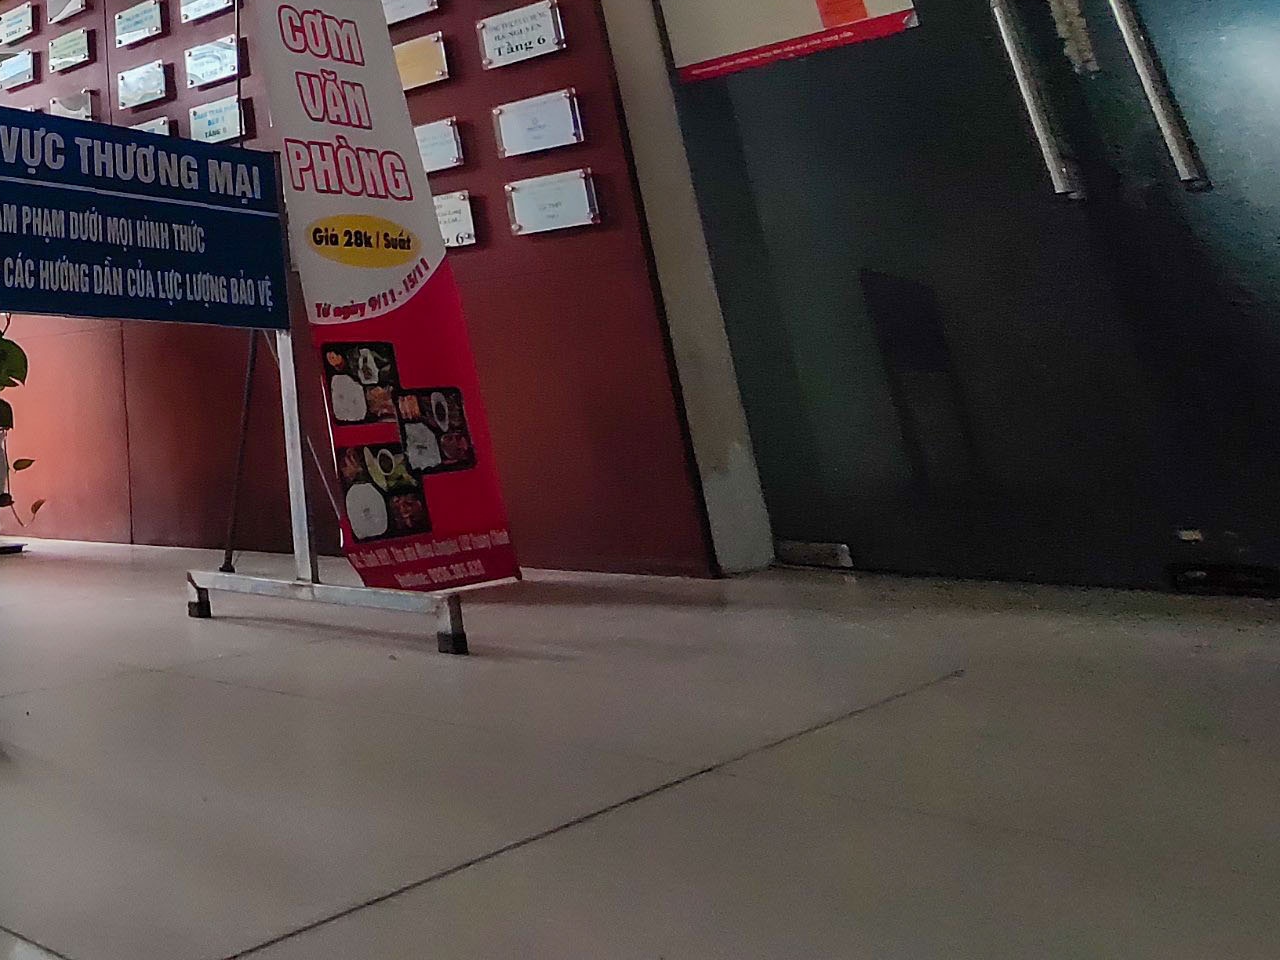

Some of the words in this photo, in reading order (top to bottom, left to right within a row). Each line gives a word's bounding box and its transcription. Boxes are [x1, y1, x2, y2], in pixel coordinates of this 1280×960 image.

[278, 4, 365, 66] CƠM
[537, 36, 546, 45] 6
[295, 69, 372, 130] VĂN
[0, 127, 66, 176] VỰC
[74, 137, 199, 190] THƯƠNG
[208, 159, 262, 204] MẠI
[284, 135, 414, 201] PHÒNG
[22, 208, 65, 244] PHẠM
[69, 206, 102, 243] DƯỚI
[106, 218, 134, 253] MỌI
[137, 214, 169, 251] HÌNH
[172, 218, 206, 255] THỨC
[312, 227, 339, 246] Giá
[344, 230, 373, 248] 28k
[384, 230, 412, 250] Suất
[3, 252, 35, 289] CÁC
[39, 254, 90, 294] HƯỚNG
[93, 256, 124, 297] DẪN
[126, 258, 155, 298] CỦA
[158, 270, 183, 306] LỰC
[186, 272, 228, 309] LƯỢNG
[230, 269, 255, 306] BẢO
[259, 275, 273, 312] VỆ
[315, 302, 332, 318] Từ
[333, 300, 366, 320] ngày
[368, 288, 397, 312] 9/11
[402, 257, 430, 293] 15/11
